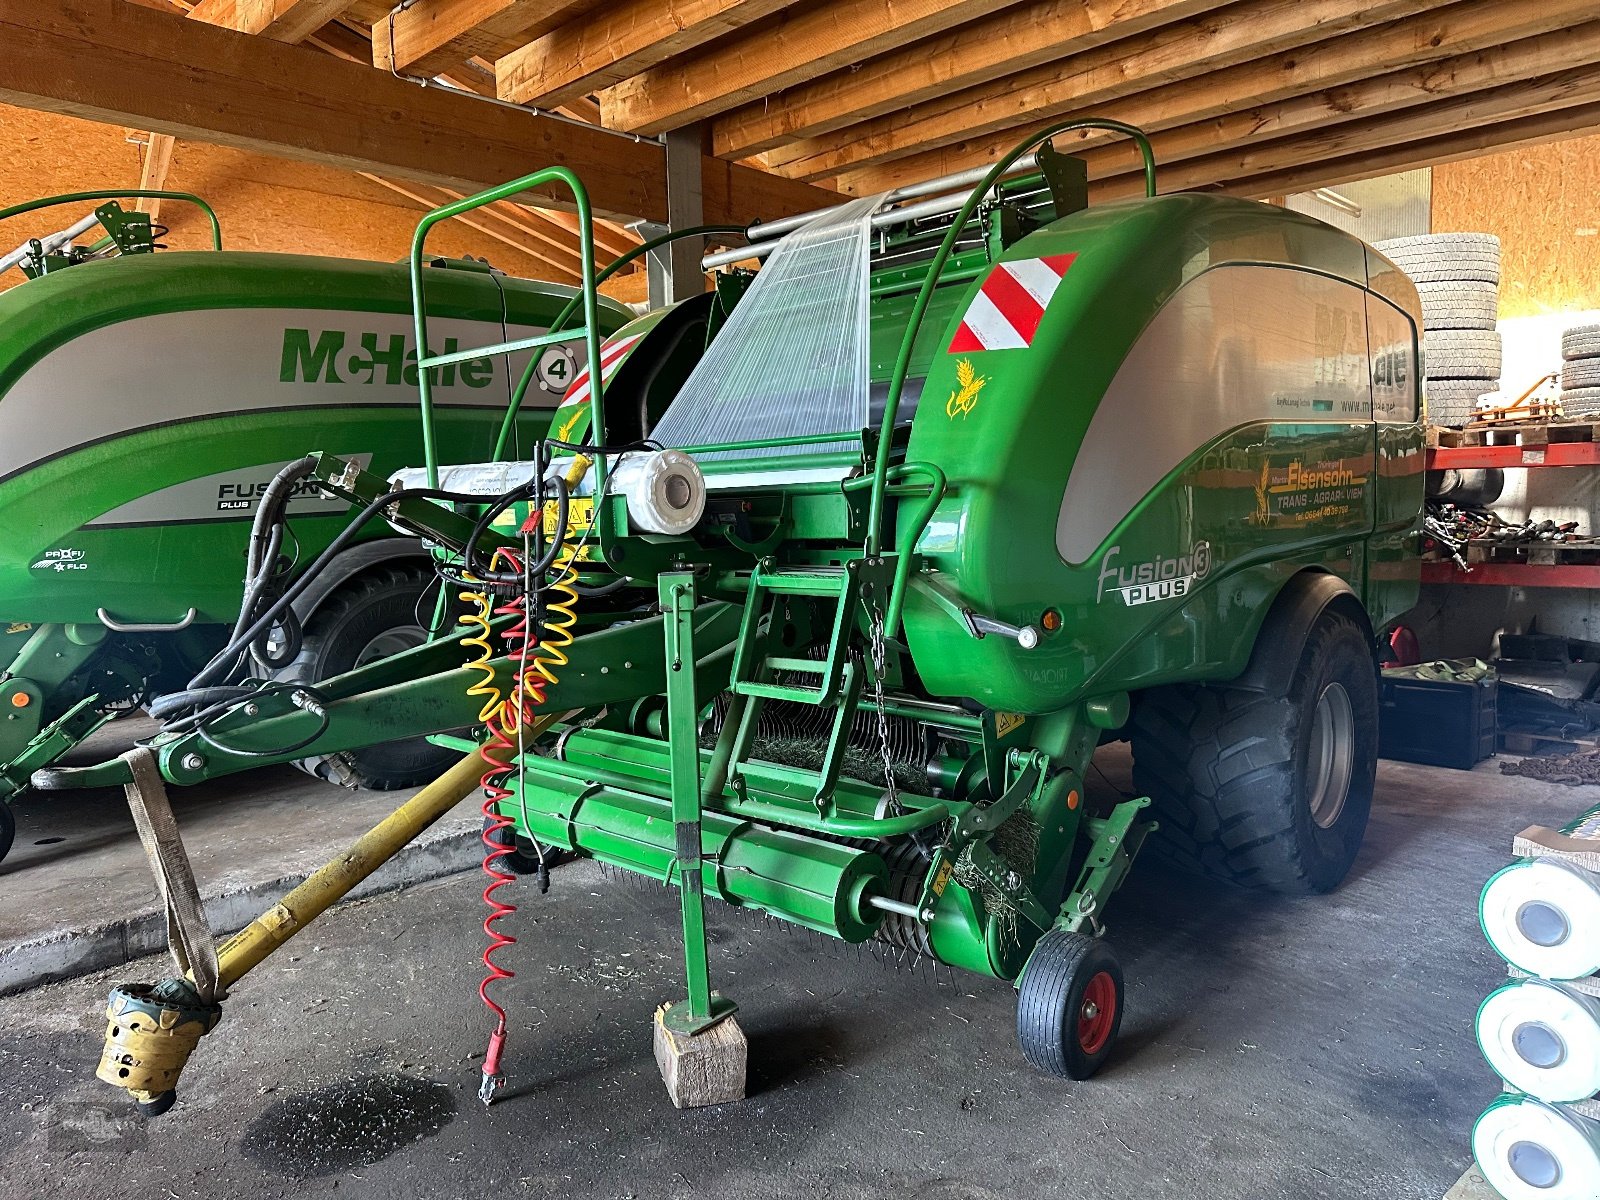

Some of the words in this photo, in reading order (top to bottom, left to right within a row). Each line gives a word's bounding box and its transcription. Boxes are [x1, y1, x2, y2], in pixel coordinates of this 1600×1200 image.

[279, 328, 494, 388] McHale
[547, 358, 568, 380] 4
[1341, 399, 1396, 414] www.mhale.net
[1288, 460, 1353, 491] Elsensohn
[219, 482, 320, 499] FUSON
[1277, 494, 1307, 509] TRANS
[1346, 488, 1363, 500] VIEH
[220, 501, 249, 509] PLUS
[45, 548, 81, 559] PROFI
[1130, 580, 1185, 605] PLUS
